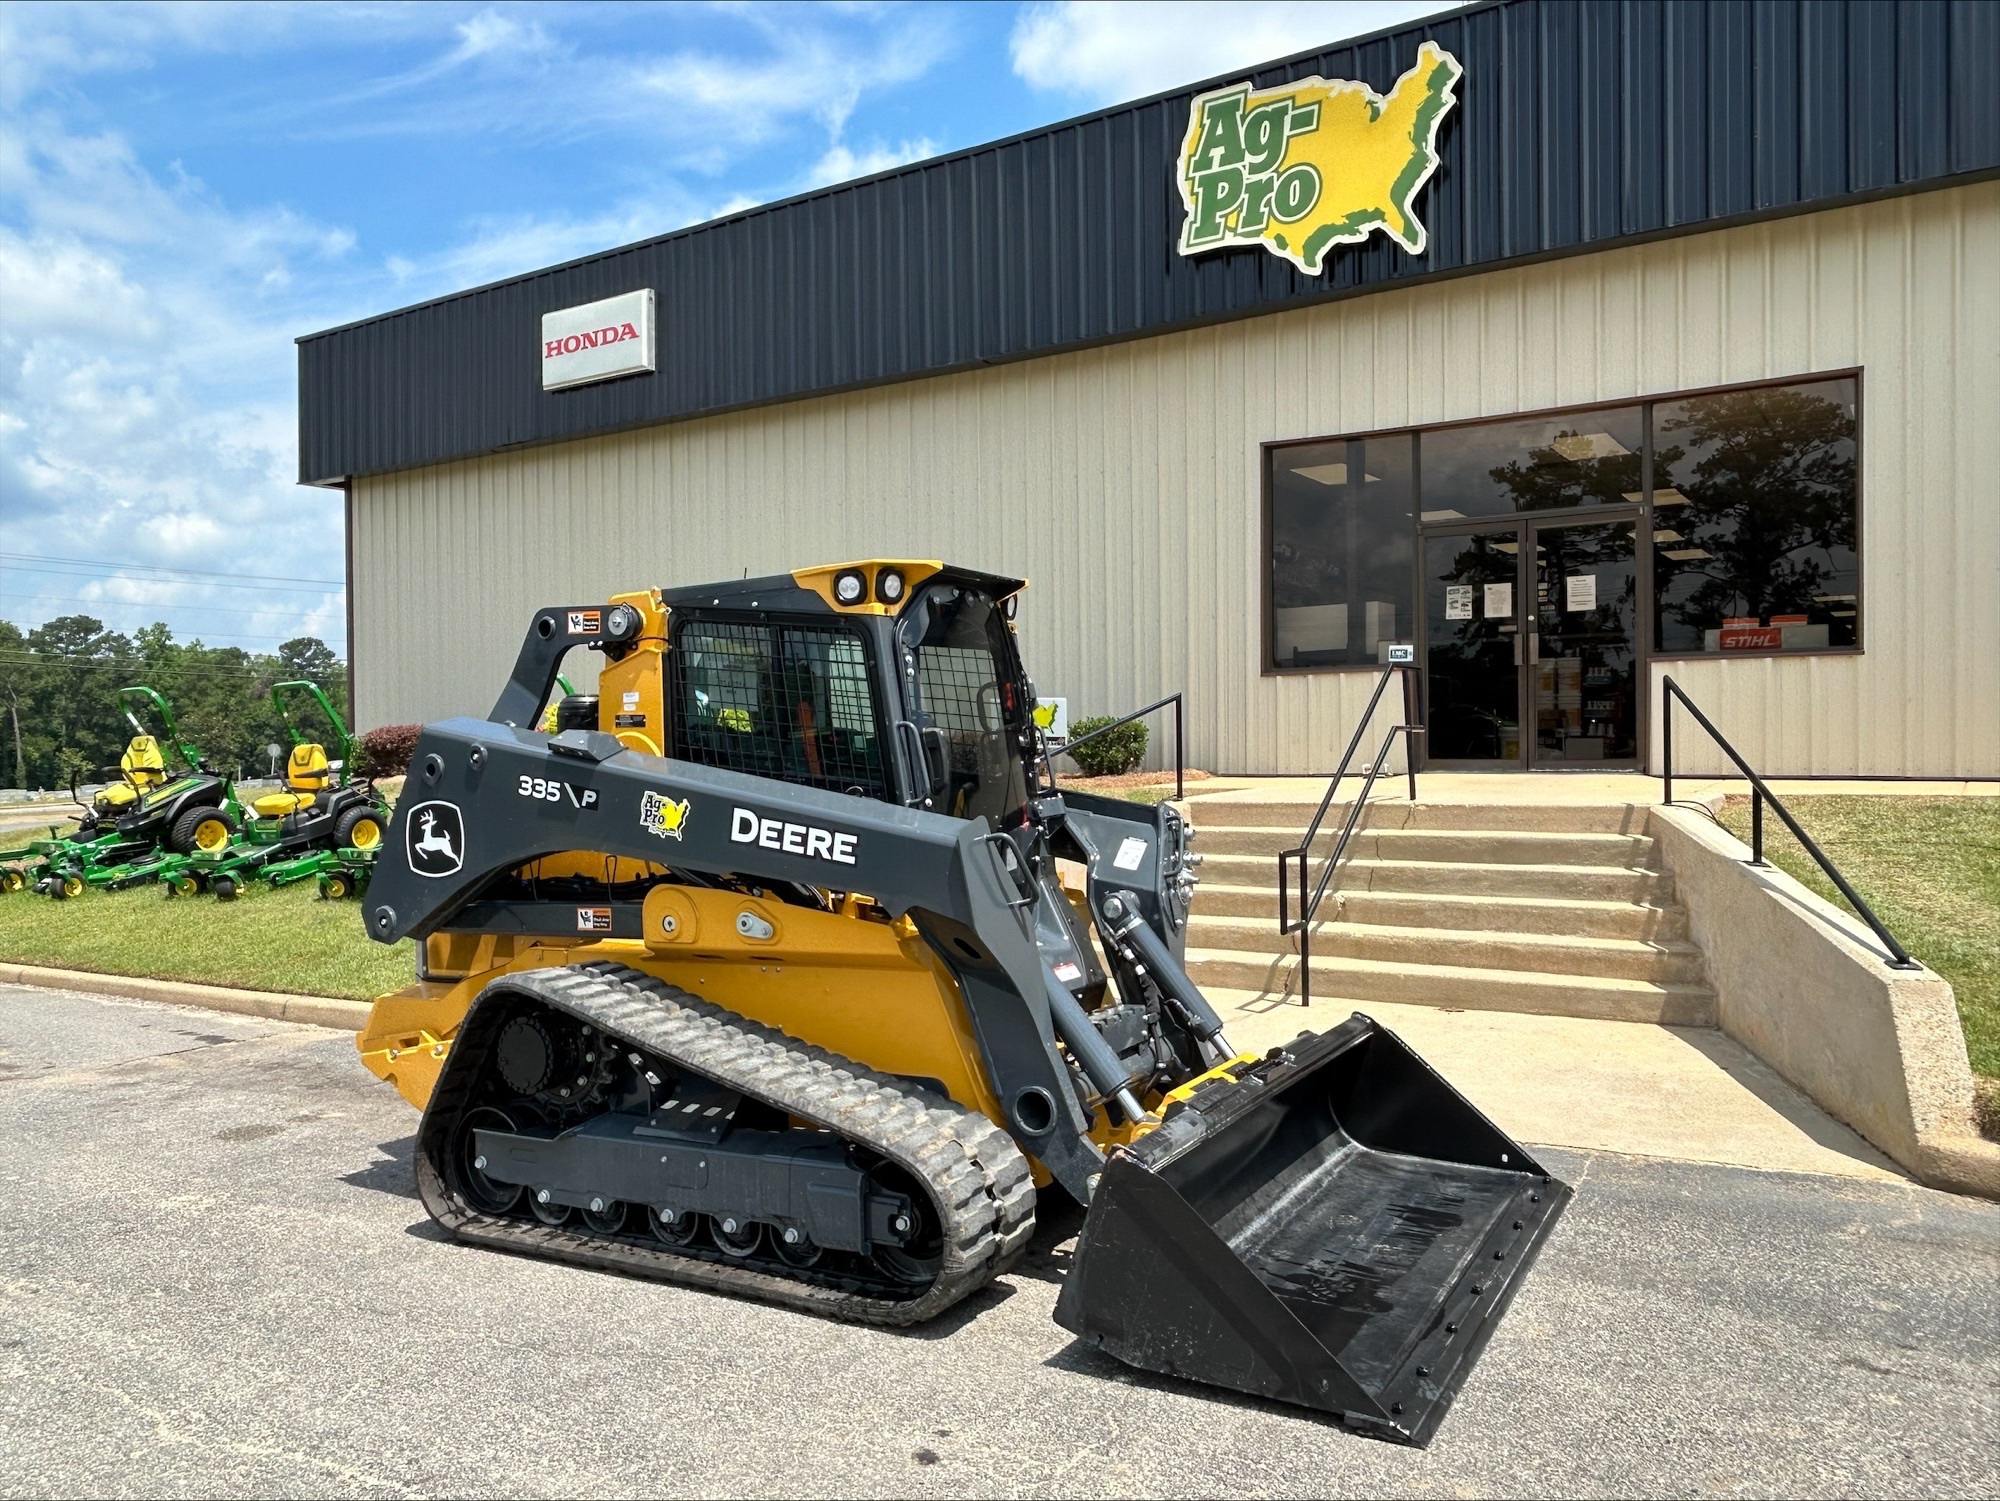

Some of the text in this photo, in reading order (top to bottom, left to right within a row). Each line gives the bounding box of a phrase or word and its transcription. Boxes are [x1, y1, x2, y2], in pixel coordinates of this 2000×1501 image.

[1190, 94, 1320, 176] Ag-
[1190, 165, 1321, 244] Pro
[545, 322, 640, 358] HONDA
[1723, 634, 1776, 648] STIHL
[518, 775, 561, 802] 335
[643, 809, 665, 824] Pro
[731, 807, 858, 865] DEERE
